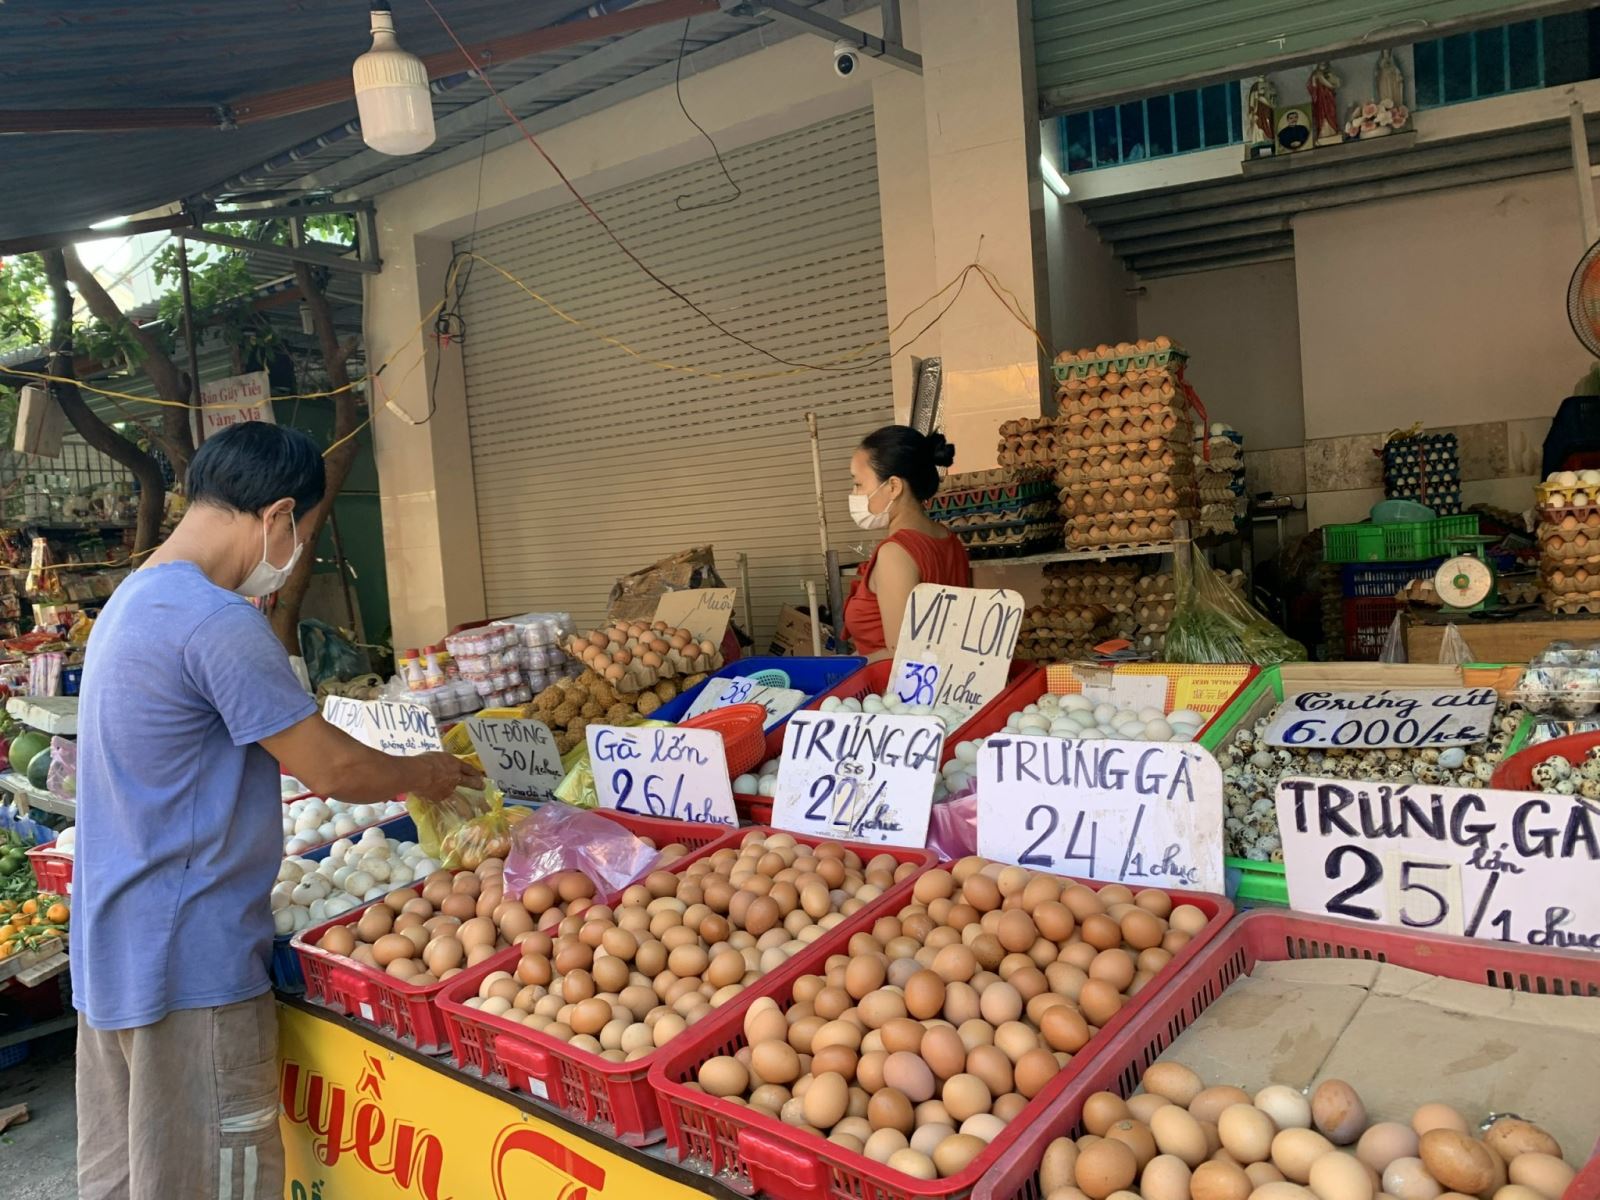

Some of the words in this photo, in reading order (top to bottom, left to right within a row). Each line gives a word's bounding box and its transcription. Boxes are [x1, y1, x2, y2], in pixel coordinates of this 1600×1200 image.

[650, 729, 709, 765] lớn
[988, 738, 1129, 790] TRỨNG
[1135, 748, 1202, 802] GÀ
[1281, 781, 1496, 849] TRỨNG
